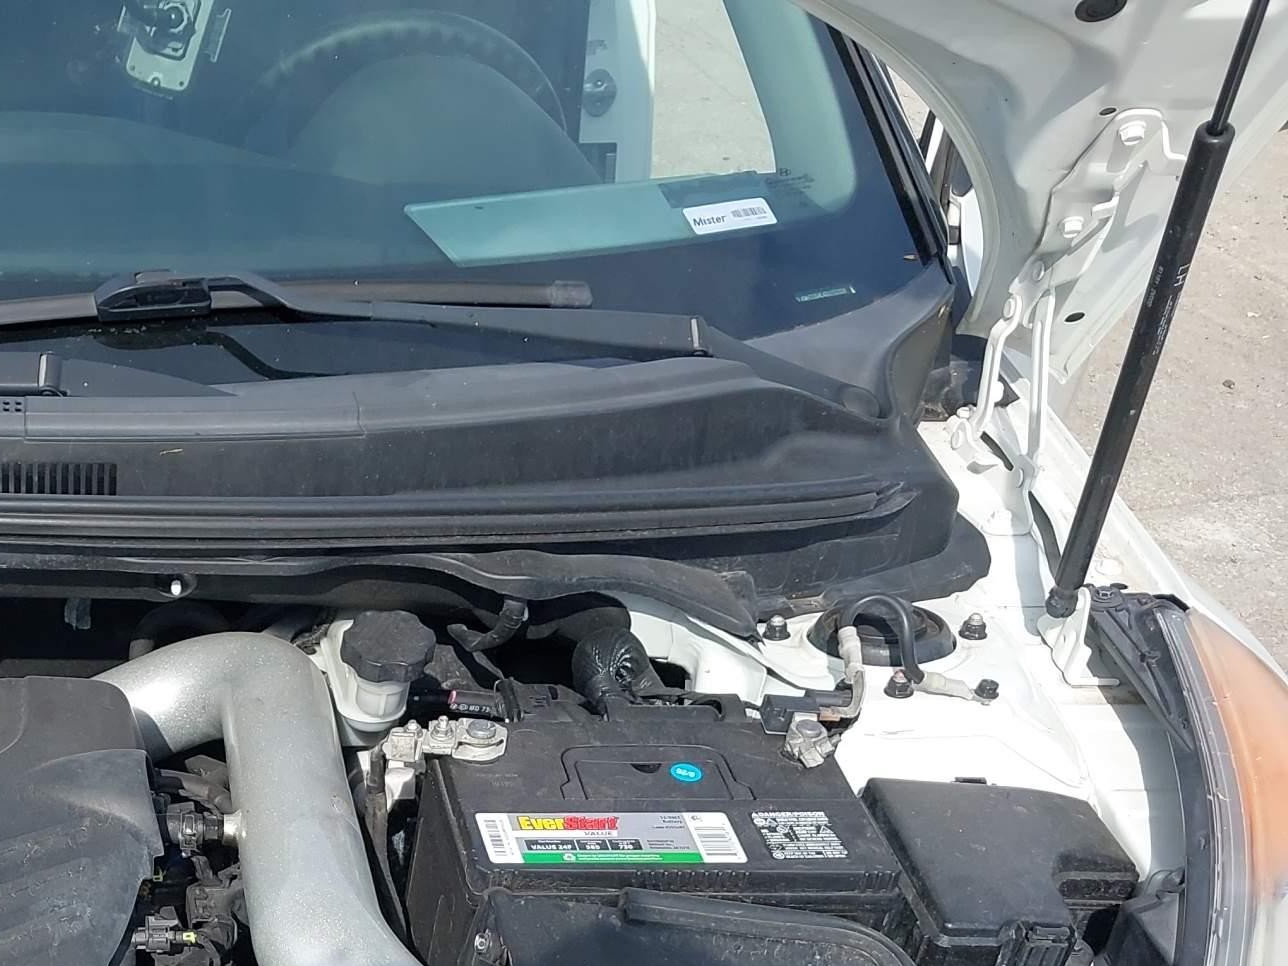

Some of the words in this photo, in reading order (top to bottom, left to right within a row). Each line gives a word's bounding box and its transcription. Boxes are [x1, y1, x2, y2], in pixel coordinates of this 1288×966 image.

[693, 214, 727, 227] Mister
[1174, 263, 1190, 287] LH
[518, 815, 617, 831] EverStart
